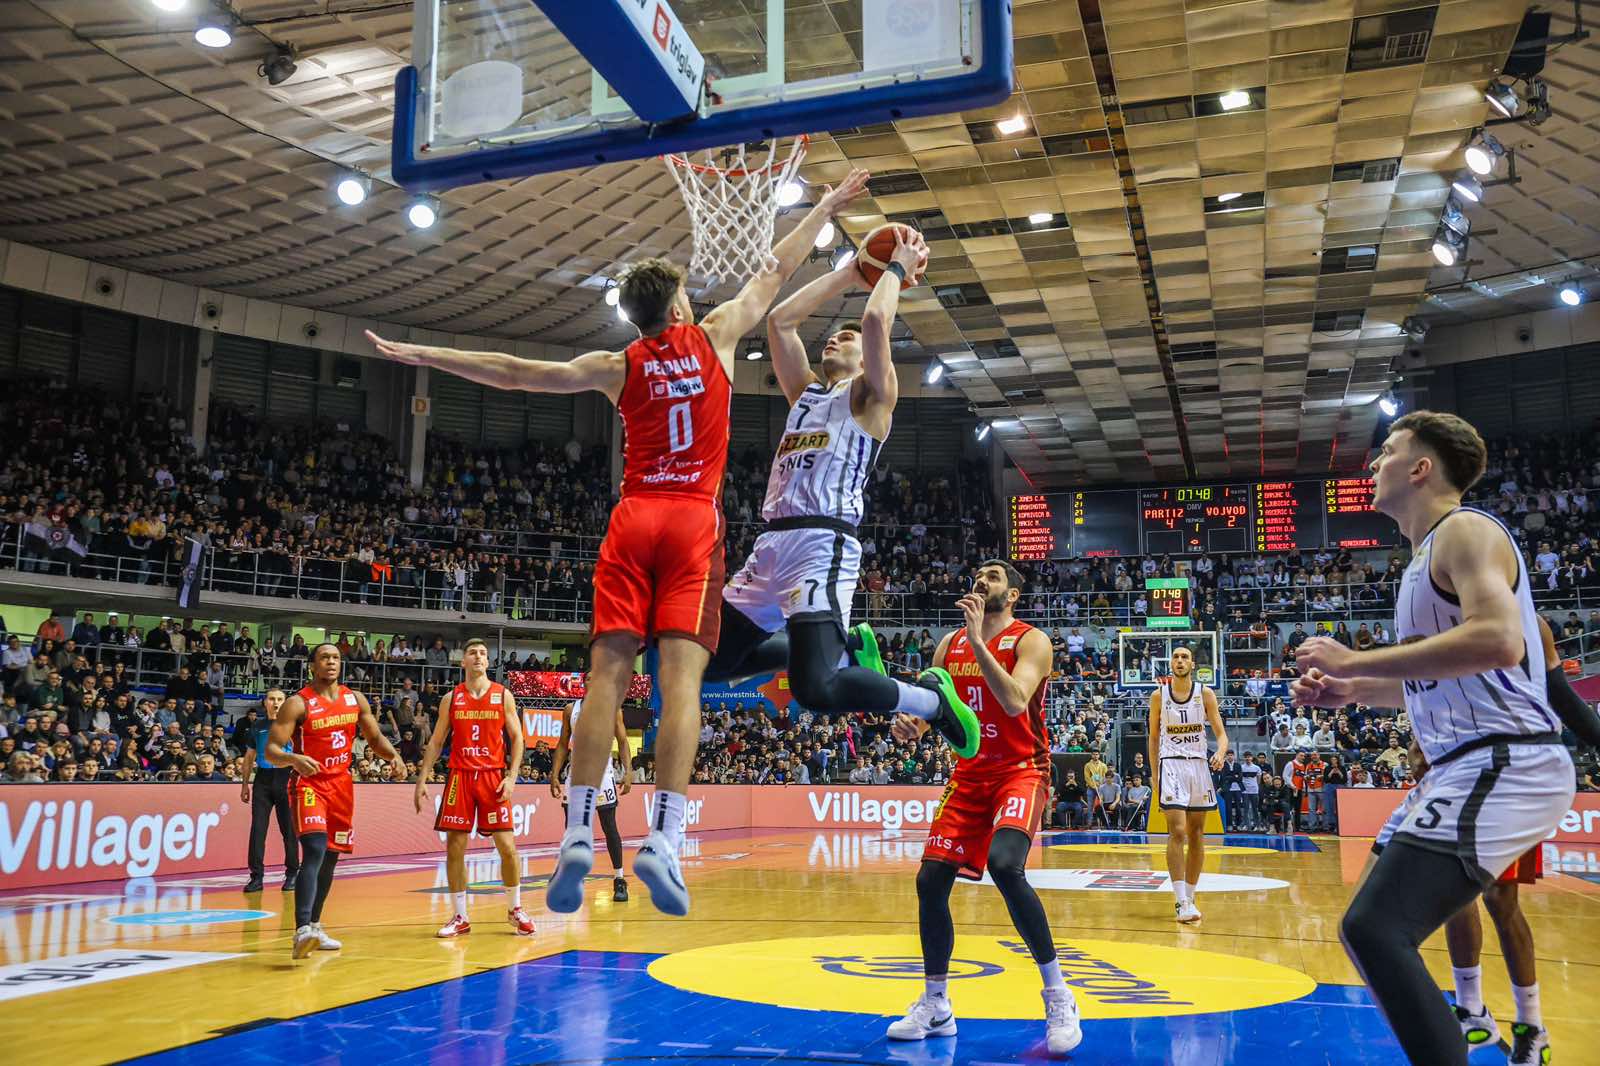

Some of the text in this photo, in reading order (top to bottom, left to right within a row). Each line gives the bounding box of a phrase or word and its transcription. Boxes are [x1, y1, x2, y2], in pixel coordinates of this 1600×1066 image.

[671, 36, 698, 86] triglav
[796, 403, 811, 430] 7
[669, 401, 694, 453] 0
[787, 454, 816, 472] NIS
[1145, 509, 1184, 519] PARTIZ
[1206, 506, 1246, 516] VOJVOD
[1166, 518, 1173, 529] 4
[1228, 516, 1235, 527] 2
[805, 579, 820, 606] 7
[701, 690, 765, 699] www.investnis.rs
[967, 686, 983, 711] 21
[1179, 710, 1188, 723] 11
[330, 730, 347, 749] 25
[472, 724, 480, 741] 2
[1184, 734, 1200, 744] NIS
[462, 744, 491, 757] mts
[325, 752, 349, 767] mts
[501, 807, 509, 823] 2
[808, 791, 942, 830] Villager
[1005, 796, 1025, 819] 21
[443, 815, 465, 825] mts
[0, 800, 220, 878] Villager
